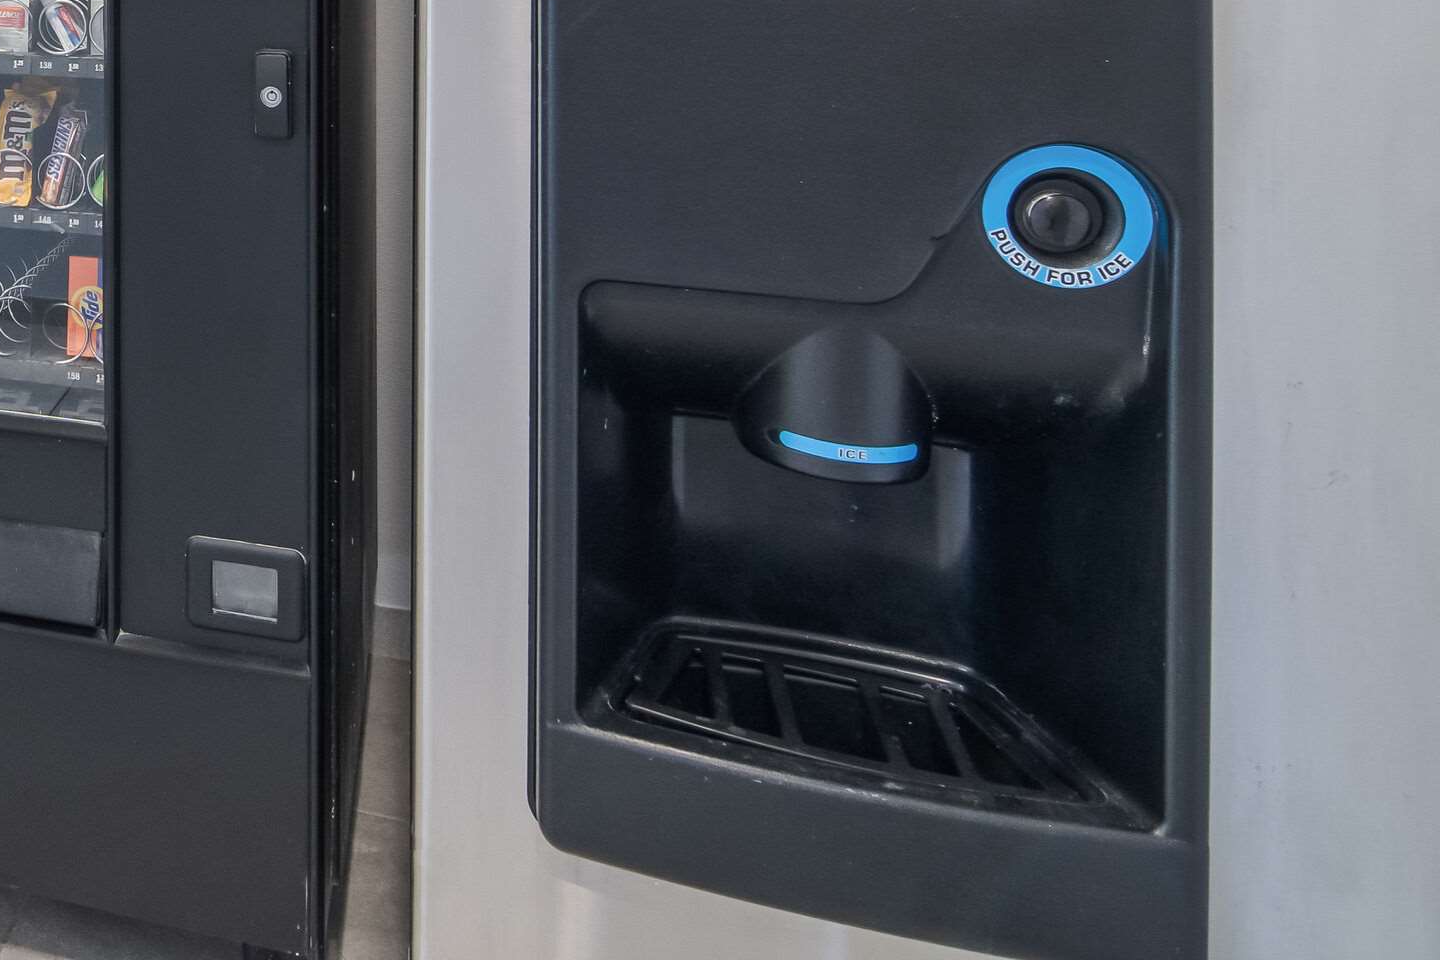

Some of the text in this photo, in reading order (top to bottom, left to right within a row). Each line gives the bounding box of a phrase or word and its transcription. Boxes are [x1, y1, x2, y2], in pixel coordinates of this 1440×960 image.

[990, 228, 1133, 287] PUSH FOR ICE
[838, 447, 868, 461] ICE
